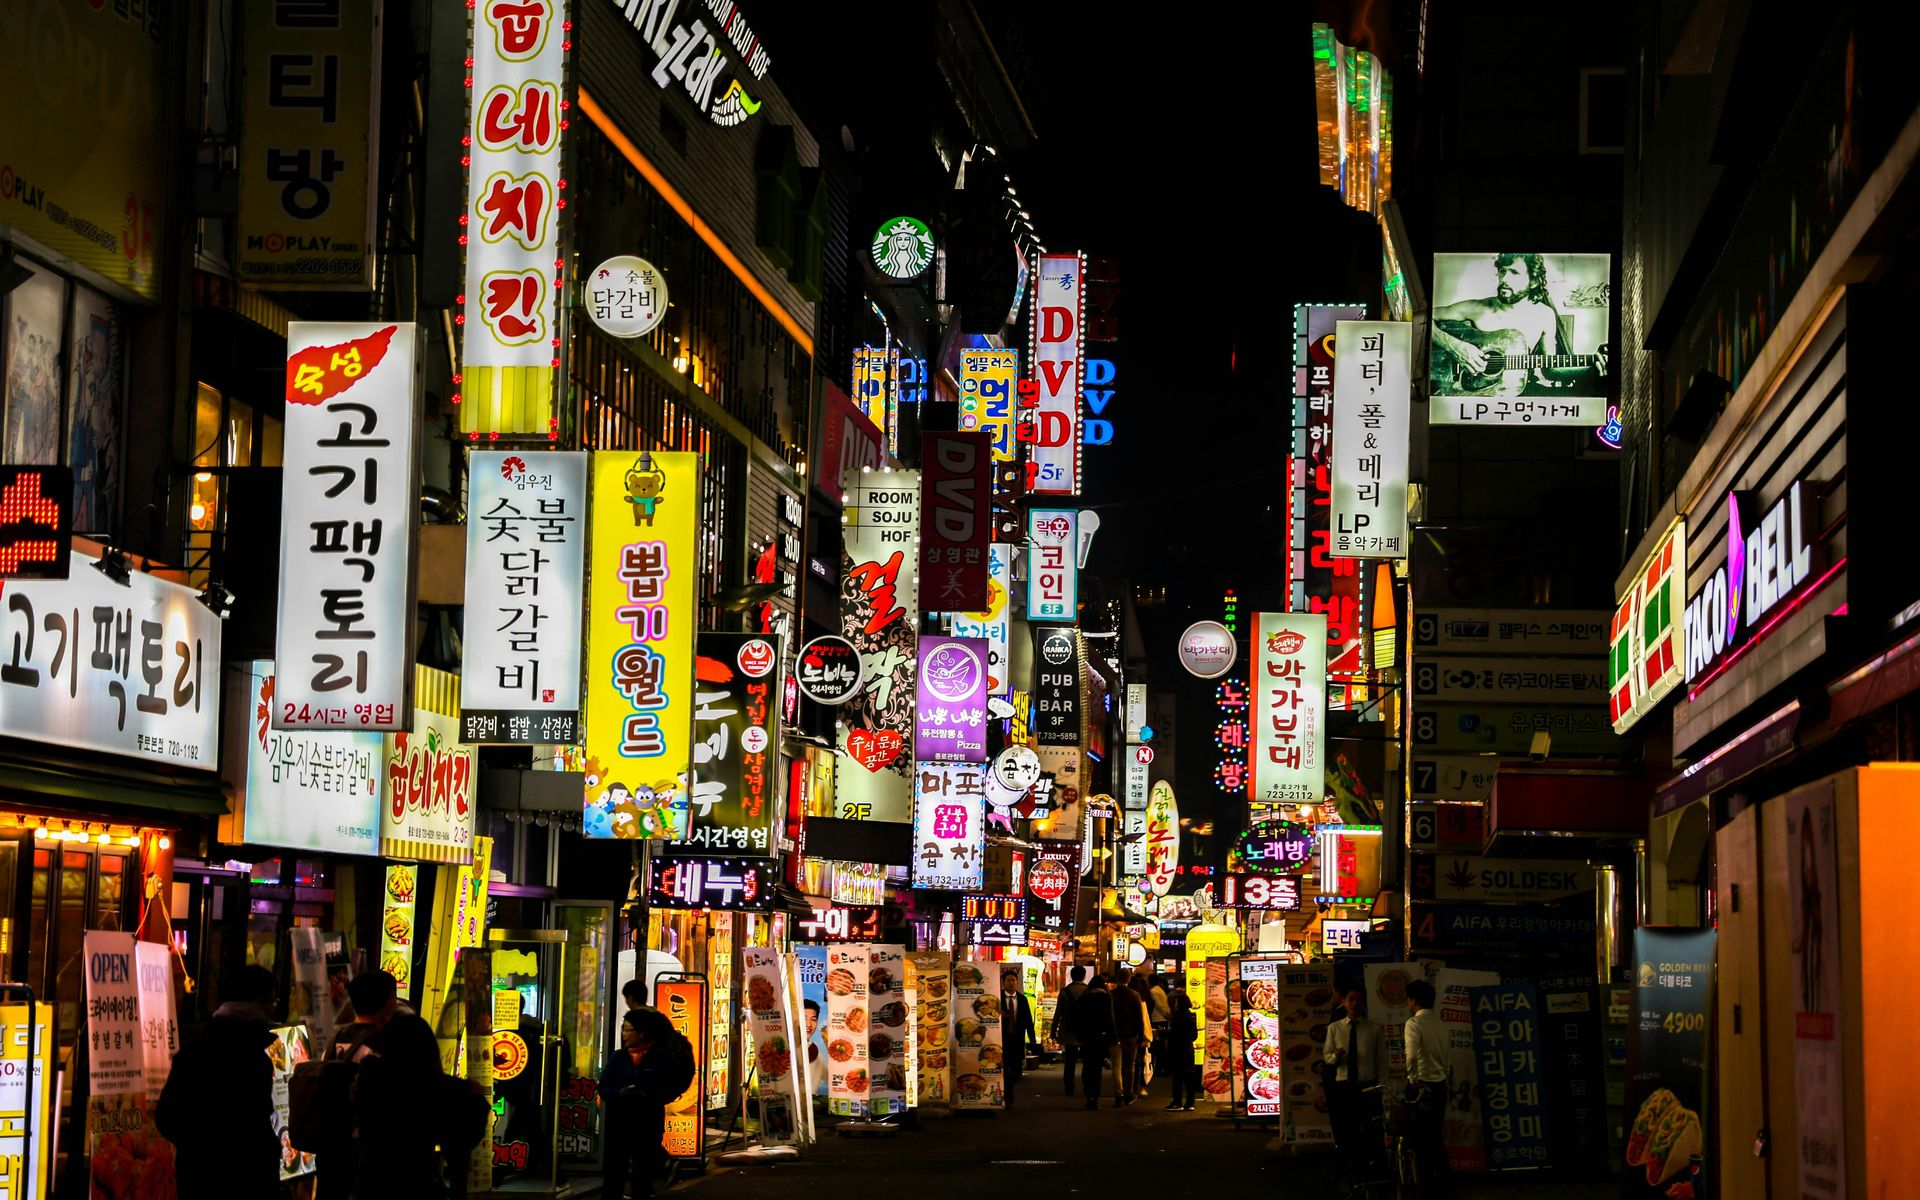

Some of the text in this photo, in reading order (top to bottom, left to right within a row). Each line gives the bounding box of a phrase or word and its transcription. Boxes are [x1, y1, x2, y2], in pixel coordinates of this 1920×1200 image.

[727, 11, 772, 81] SOJU HOF
[625, 269, 655, 286] 숯불
[592, 287, 658, 320] 닭갈비
[293, 346, 362, 396] 숙성
[965, 356, 1014, 373] 엠플러스
[1037, 306, 1075, 448] DVD
[1082, 358, 1117, 445] DVD
[1459, 401, 1580, 423] LP 구멍가게
[513, 474, 553, 491] 김우진
[1040, 462, 1065, 481] 5F
[868, 491, 914, 504] ROOM
[935, 437, 978, 544] DVD
[480, 497, 576, 544] 숯불
[872, 511, 912, 523] SOJU
[1338, 513, 1371, 534] LP
[880, 530, 912, 542] HOF
[1337, 536, 1400, 552] 음악카페
[308, 402, 391, 694] 고기팩토리
[927, 546, 981, 565] 상영관
[1039, 545, 1064, 600] 코인
[1683, 480, 1811, 685] TACO BELL
[1044, 604, 1060, 614] 3F
[496, 548, 551, 701] 닭갈비
[1417, 617, 1436, 642] 9
[0, 591, 203, 732] 고기팩토리
[1184, 645, 1230, 656] 박가부대
[1040, 673, 1074, 687] PUB
[1417, 666, 1436, 690] 8
[1052, 688, 1060, 698] &
[283, 702, 395, 725] 24시간 영업
[1039, 699, 1073, 713] BAR
[1266, 659, 1306, 770] 박가부대
[466, 715, 573, 740] 닭갈비 닭발 삼겹살
[1050, 716, 1065, 726] 3F
[1416, 716, 1435, 741] 8
[877, 735, 901, 750] 문화
[956, 740, 982, 751] Pizza
[957, 730, 964, 739] &
[1038, 731, 1078, 741] T.733-5858
[1221, 685, 1245, 788] 노래방
[168, 738, 200, 760] 720-1192
[864, 751, 889, 769] 공간
[388, 731, 472, 818] 굽네치킨
[1003, 758, 1039, 780] 곱창
[1417, 762, 1433, 791] 7
[921, 770, 984, 797] 마포
[1266, 790, 1313, 800] 723-2112
[842, 802, 872, 821] 2F
[936, 822, 964, 837] 구이
[1415, 814, 1432, 840] 6
[920, 842, 979, 869] 곱창
[1037, 851, 1072, 863] Luxury
[1147, 820, 1175, 885] 노래방
[1246, 840, 1306, 861] 노래방
[934, 875, 978, 885] 732-1197
[1029, 876, 1067, 891] 羊肉串
[1481, 870, 1579, 891] SOLDESK
[1244, 877, 1297, 908] 3층
[966, 899, 1015, 919] DVD
[798, 908, 849, 938] 구이
[1451, 915, 1494, 930] AIFA
[1495, 917, 1595, 934] 우리경영아카데
[91, 953, 130, 984] OPEN
[140, 962, 169, 992] OPEN
[1658, 962, 1692, 973] GOLDEN
[1658, 975, 1692, 988] 더블타코
[1476, 991, 1533, 1013] AIFA
[1662, 1011, 1705, 1035] 4900
[92, 1030, 134, 1050] 양념갈비
[1480, 1019, 1514, 1144] 우리경영
[1507, 1017, 1544, 1140] 아카데미
